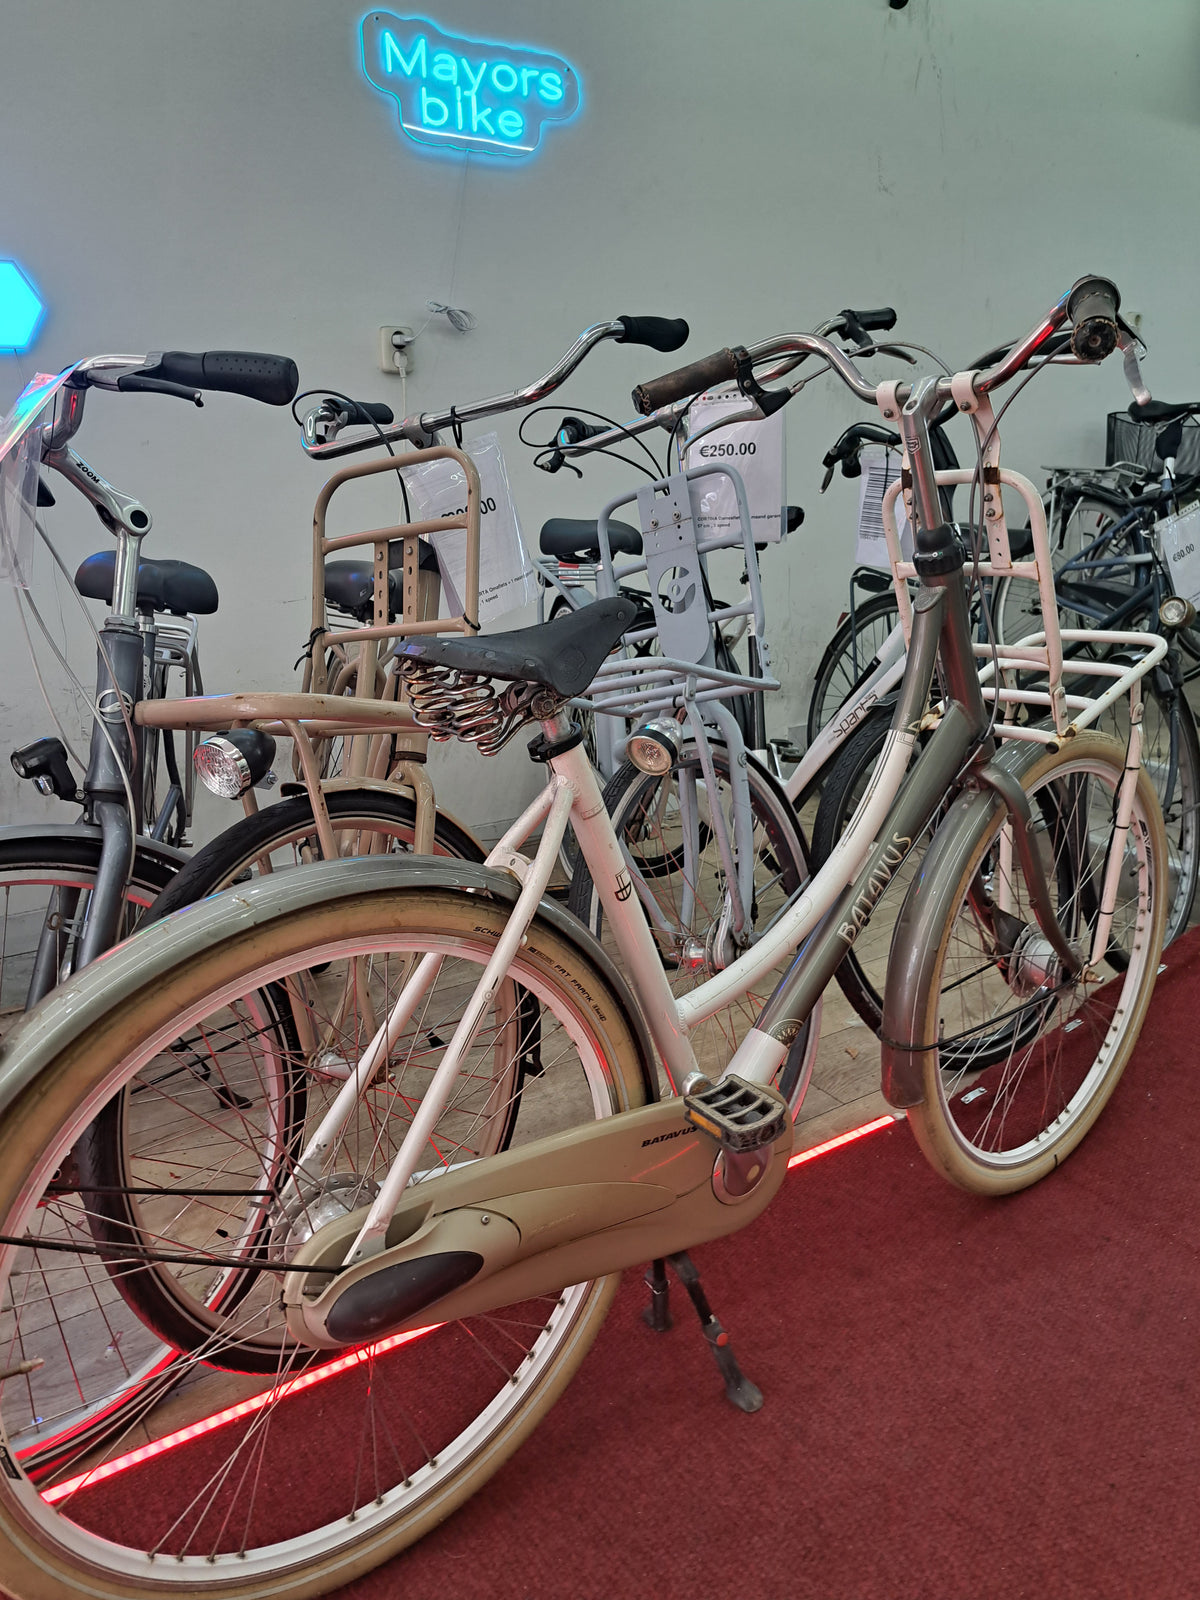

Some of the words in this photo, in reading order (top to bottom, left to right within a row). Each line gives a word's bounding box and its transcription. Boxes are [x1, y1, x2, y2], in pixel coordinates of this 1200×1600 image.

[384, 31, 563, 101] Mayors
[420, 85, 524, 138] bike
[700, 442, 756, 458] €250.00
[76, 461, 100, 484] ZOOM
[837, 831, 912, 945] BATAVUS
[554, 964, 571, 977] FAT
[641, 1125, 698, 1147] BATAVUS
